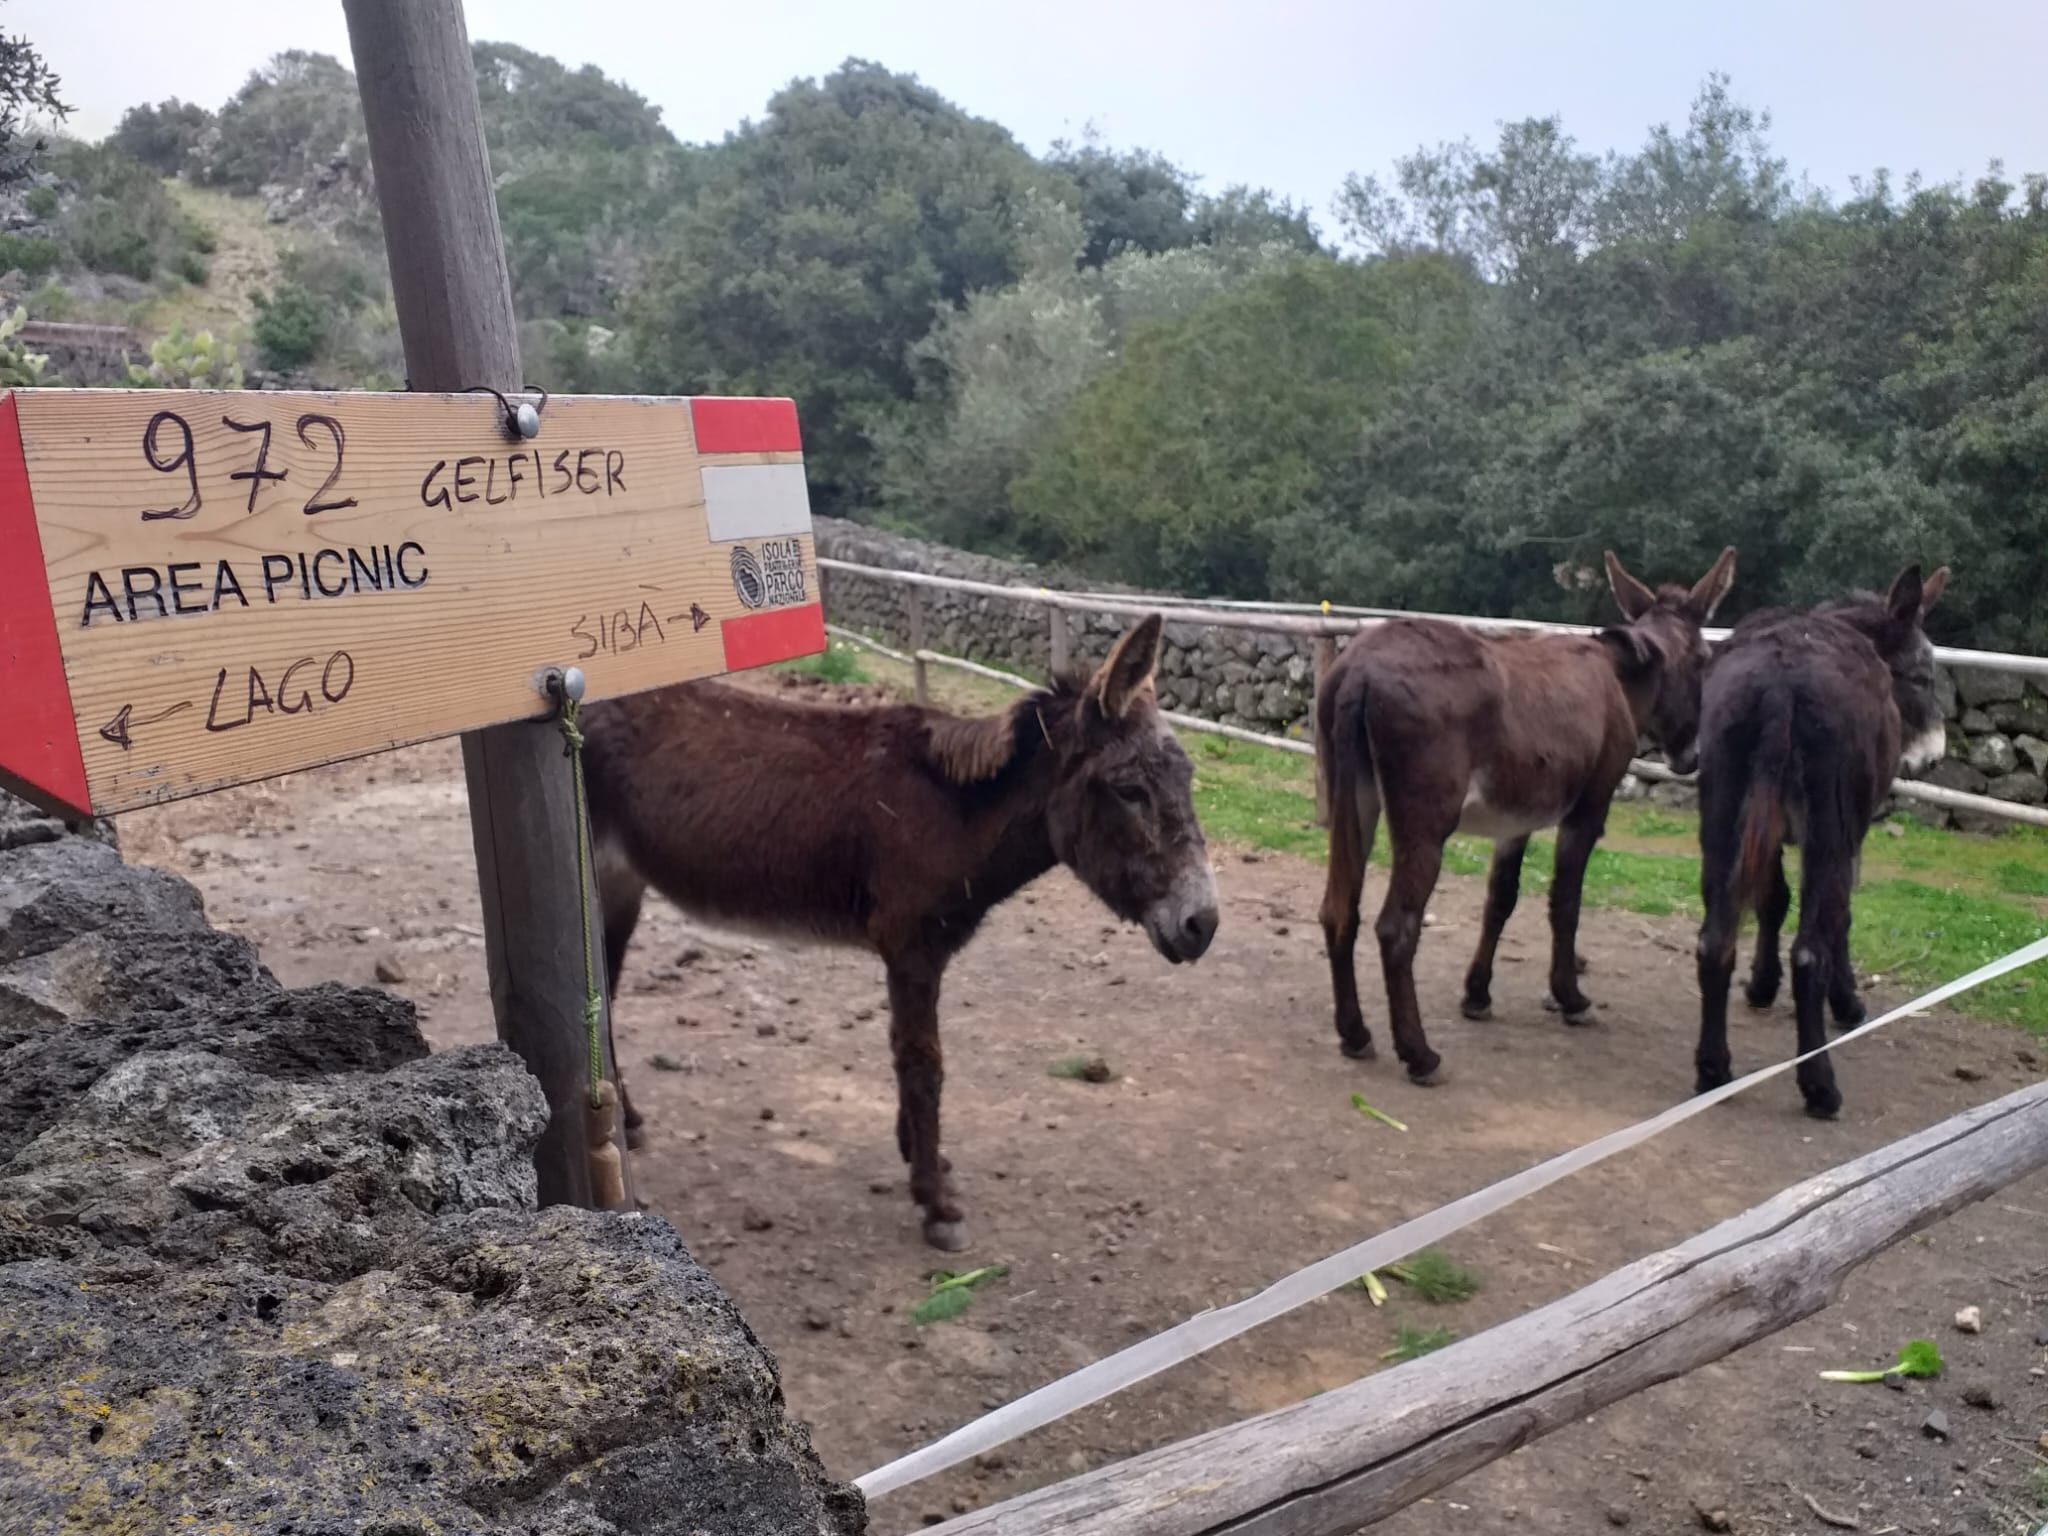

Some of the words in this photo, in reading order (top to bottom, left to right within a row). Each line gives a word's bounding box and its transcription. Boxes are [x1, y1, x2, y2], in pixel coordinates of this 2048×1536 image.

[142, 411, 358, 521] 972
[421, 449, 627, 511] GELFISER
[81, 557, 249, 627] AREA
[261, 541, 428, 603] PICNIC
[761, 541, 792, 561] ISOLA
[765, 570, 804, 594] PARCO
[205, 650, 355, 731] LAGO
